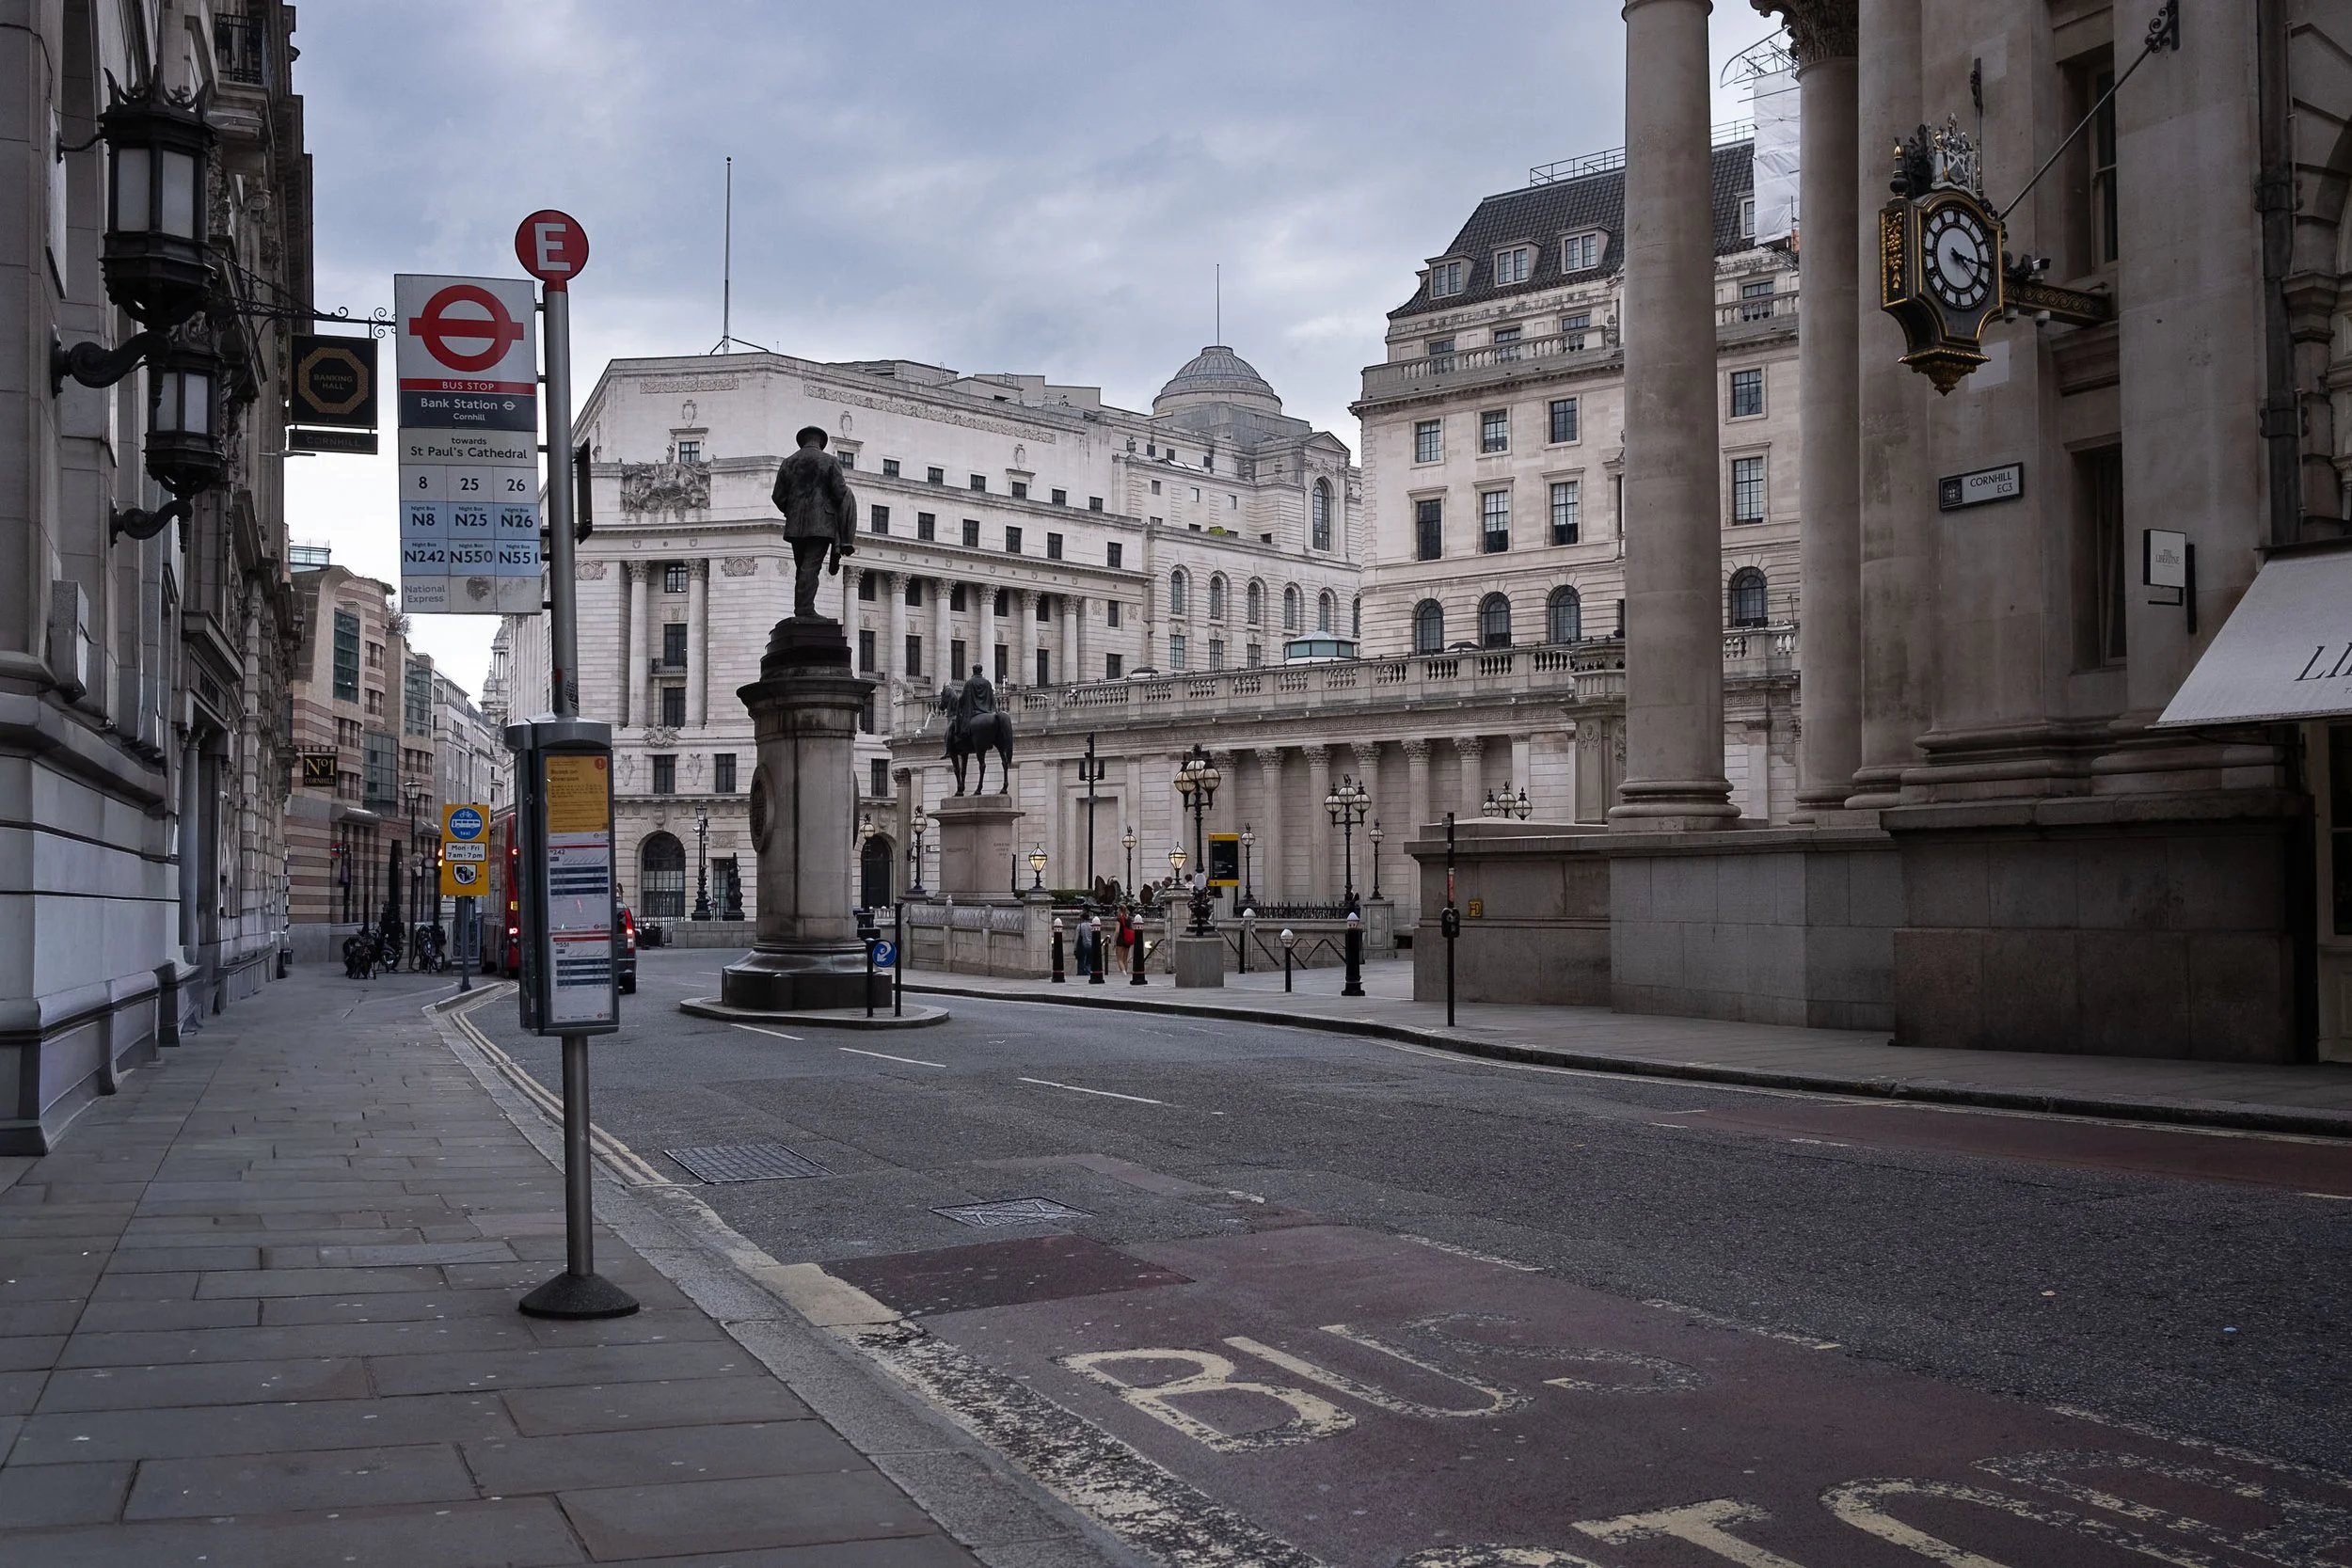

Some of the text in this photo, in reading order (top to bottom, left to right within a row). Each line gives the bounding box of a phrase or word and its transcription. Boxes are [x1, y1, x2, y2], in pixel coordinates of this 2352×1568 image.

[534, 222, 571, 272] E
[314, 374, 353, 383] BANKING
[441, 380, 495, 391] BUS STOP
[421, 397, 498, 411] Bank Station
[453, 412, 485, 421] Cornhill
[306, 436, 360, 446] CORNHILL
[411, 446, 528, 459] St Paul's Cathedral
[418, 476, 428, 489] 8
[460, 477, 479, 491] 25
[506, 478, 526, 491] 26
[1970, 471, 2012, 488] CORNHILL
[1996, 483, 2013, 494] EC3
[412, 513, 435, 526] N8
[455, 514, 488, 527] N25
[501, 515, 533, 528] N26
[404, 550, 445, 562] N242
[450, 551, 493, 563] N550
[499, 552, 539, 564] N551
[407, 595, 445, 603] Express
[1047, 1313, 1712, 1452] BUS
